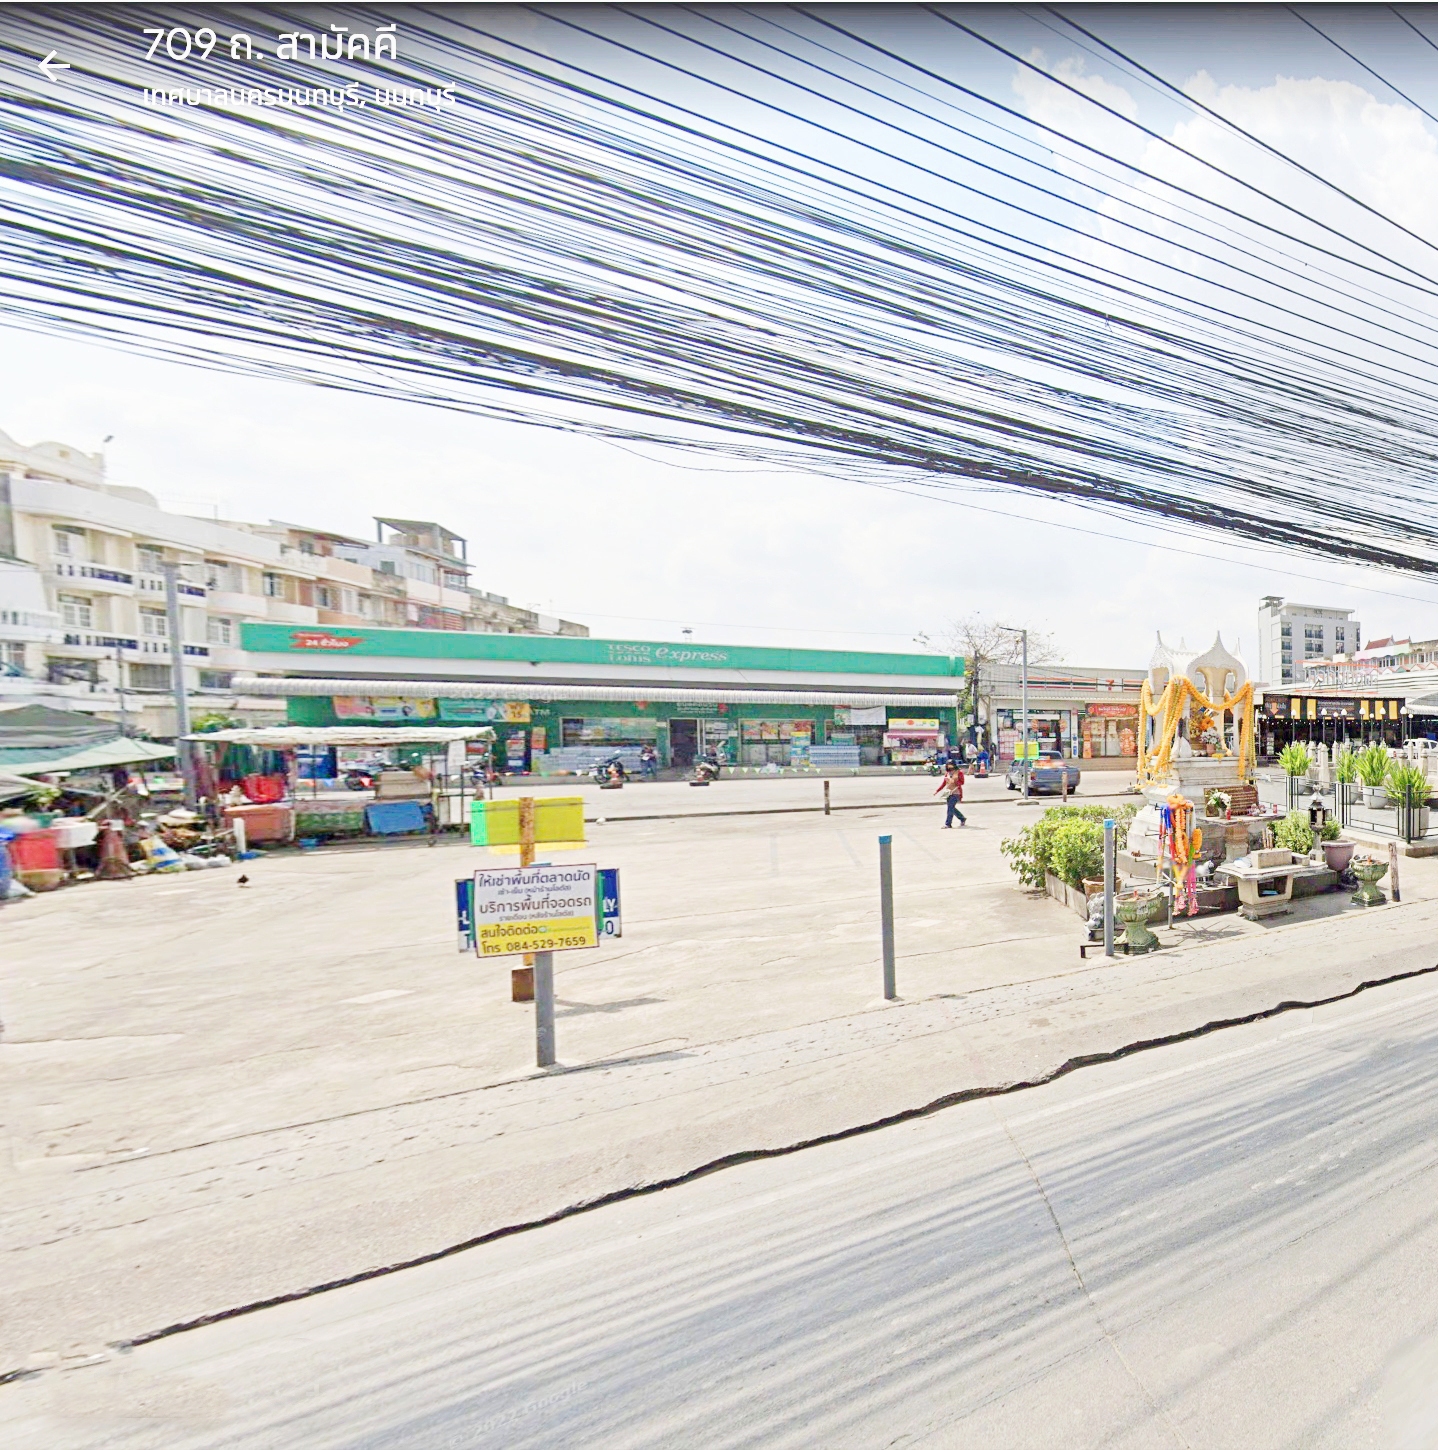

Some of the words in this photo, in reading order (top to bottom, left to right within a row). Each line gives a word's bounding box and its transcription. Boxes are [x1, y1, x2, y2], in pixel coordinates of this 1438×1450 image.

[655, 646, 728, 662] express
[479, 870, 590, 888] ให้เช่าพื้นที่ตลาดนัด
[479, 894, 592, 914] บริการพื้นที่จอดรถ
[481, 924, 538, 938] สนใจติดต่อ
[507, 936, 586, 952] 084-529-7659
